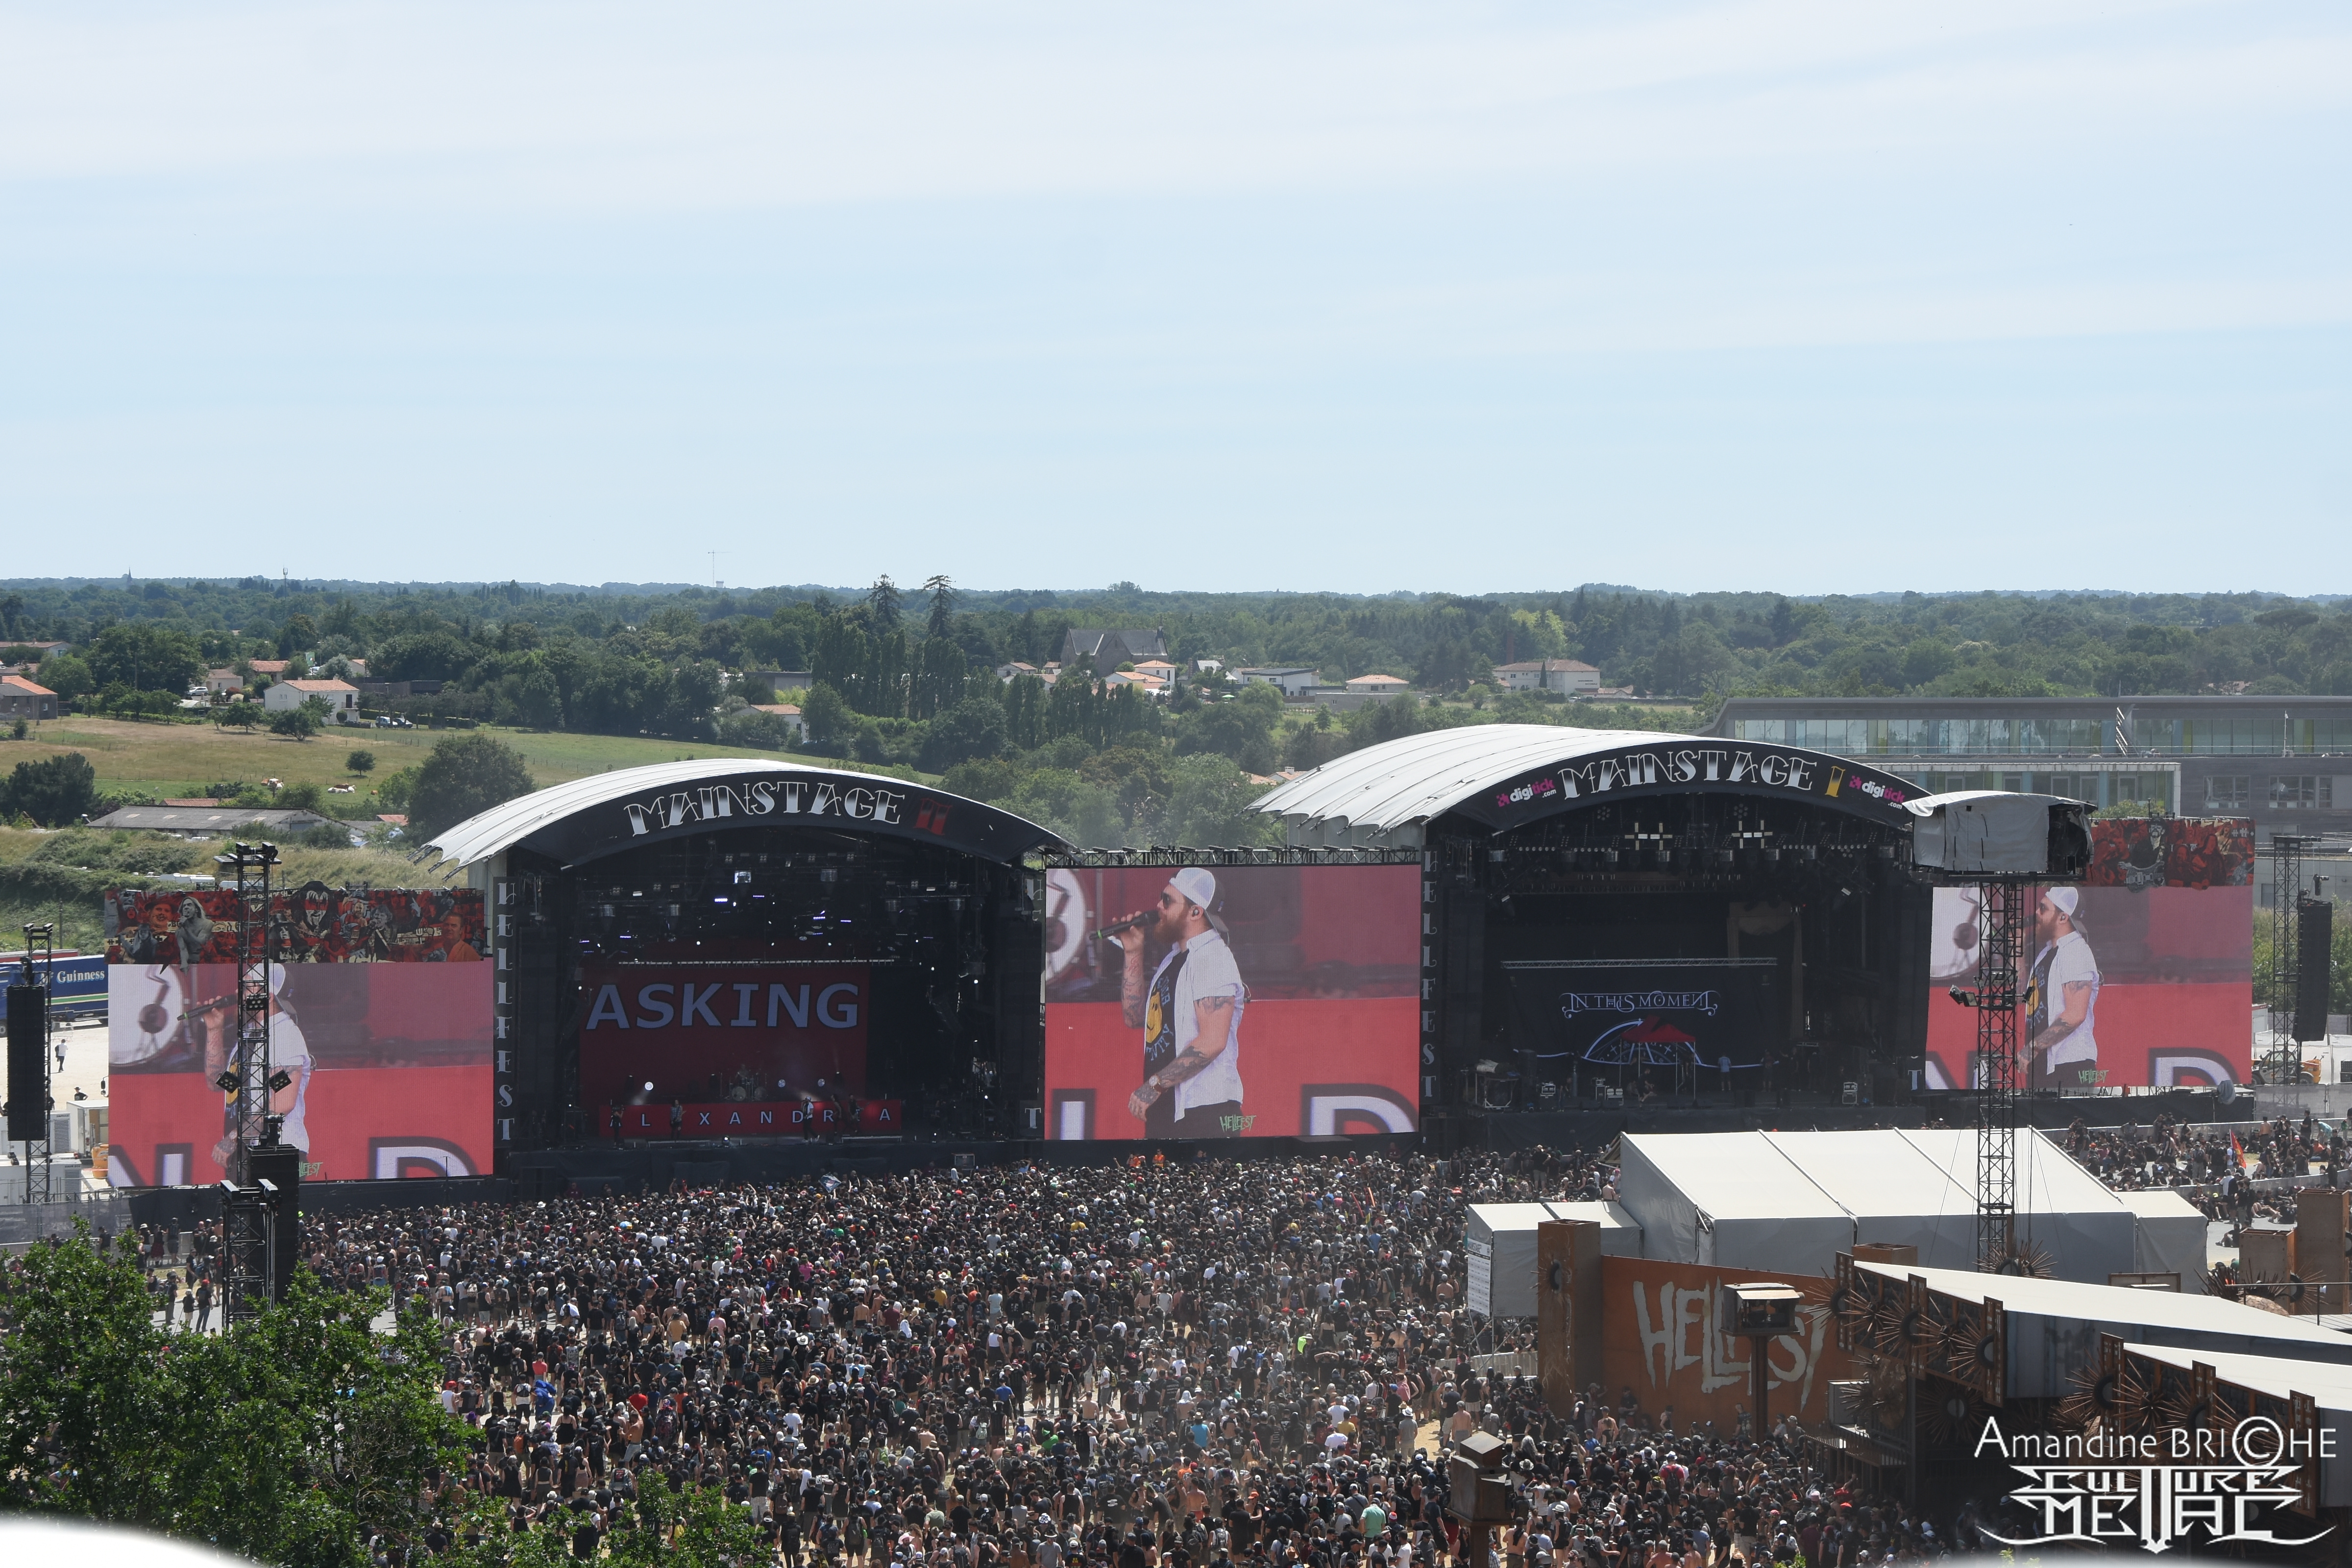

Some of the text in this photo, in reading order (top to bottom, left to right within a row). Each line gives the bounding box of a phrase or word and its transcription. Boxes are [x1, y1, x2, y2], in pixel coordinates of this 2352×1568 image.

[1558, 750, 1816, 800] MAINSTAGE
[1510, 779, 1555, 802] digitick
[1862, 781, 1905, 804] digitick
[623, 782, 905, 836] MAINSTAGE
[57, 970, 105, 984] Guinness
[587, 983, 858, 1029] ASKING
[2078, 1069, 2109, 1084] HELLFEST
[610, 1108, 891, 1127] LXANDRA
[1220, 1114, 1256, 1132] HELLFEST
[1633, 1275, 1832, 1414] HELLST
